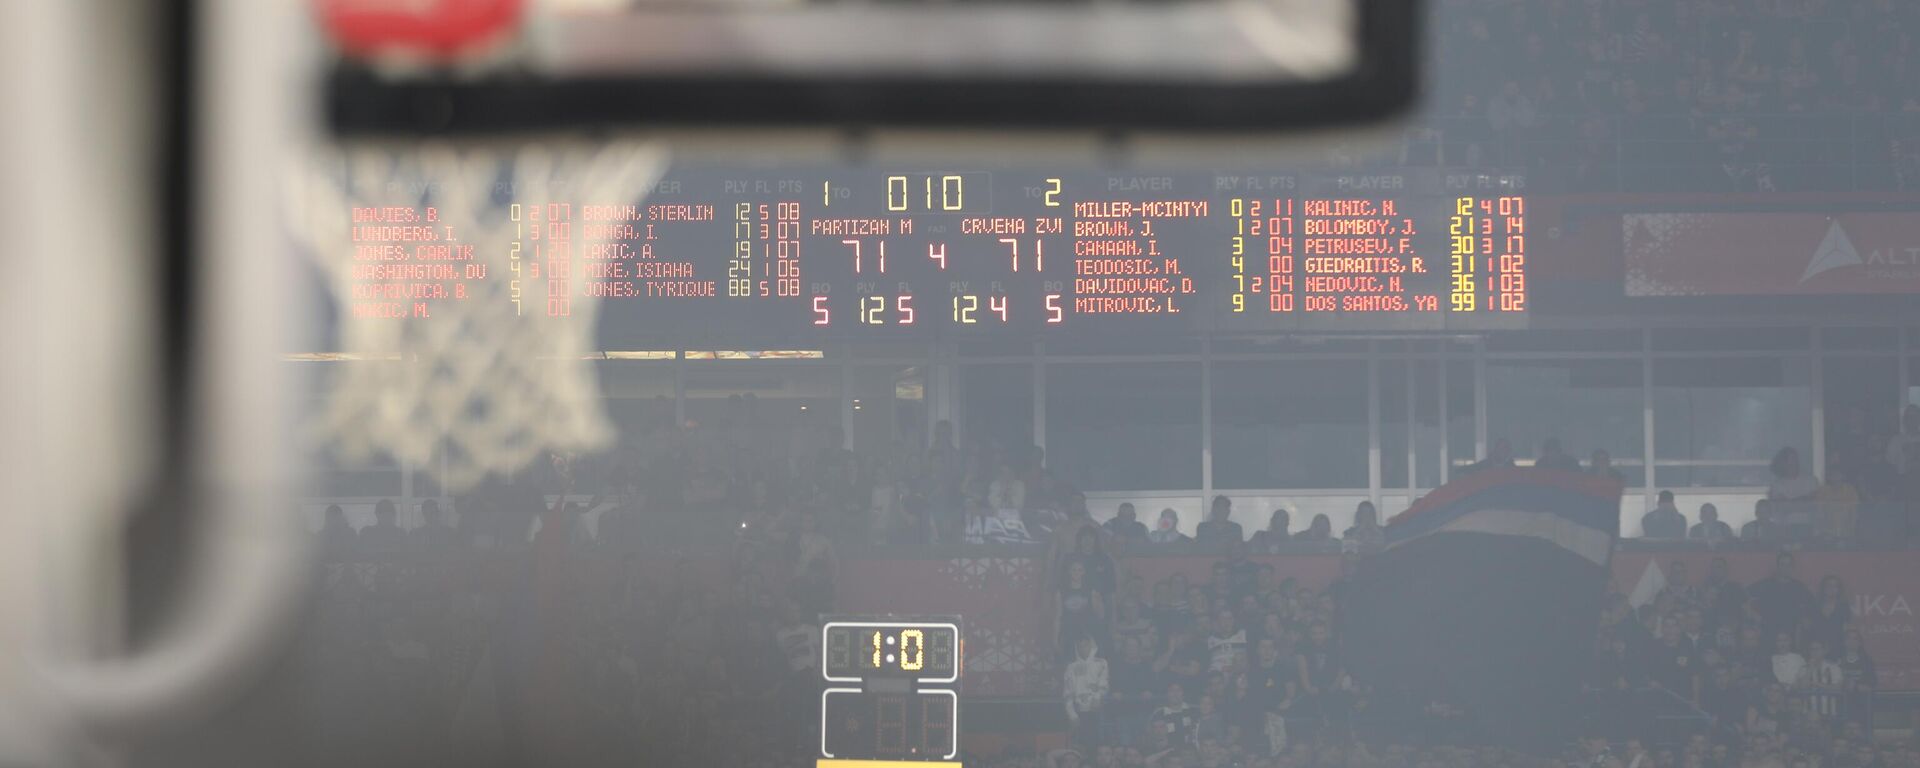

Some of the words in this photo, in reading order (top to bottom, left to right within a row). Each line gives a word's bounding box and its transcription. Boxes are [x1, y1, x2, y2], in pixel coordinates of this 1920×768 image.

[724, 180, 748, 193] PLY
[756, 180, 771, 193] FL
[778, 180, 803, 193] PTS
[1108, 177, 1173, 191] PLAYER
[1217, 177, 1240, 190] PLY
[1248, 177, 1262, 190] FL
[1270, 177, 1295, 189] PTS
[1338, 176, 1404, 189] PLAYER
[1446, 176, 1470, 188] PLY
[1500, 175, 1525, 188] PTS
[824, 180, 829, 207] 1
[832, 187, 851, 199] TO
[1024, 187, 1042, 198] TO
[1045, 178, 1061, 207] 2
[352, 207, 421, 222] DAVIES,
[427, 207, 441, 222] B.
[511, 203, 521, 221] 0
[529, 205, 540, 220] 2
[548, 203, 570, 221] 07
[583, 205, 641, 221] BROWN,
[648, 205, 714, 221] STERLIN
[734, 202, 751, 221] 12
[759, 204, 769, 220] 5
[777, 202, 800, 221] 08
[1074, 201, 1208, 217] MILLER-MCINTY
[1231, 198, 1242, 217] 0
[1250, 201, 1261, 217] 2
[1276, 199, 1293, 216] 11
[1305, 200, 1377, 216] KALINIC,
[1382, 200, 1398, 216] N.
[1456, 197, 1473, 215] 12
[1480, 200, 1492, 215] 4
[1499, 197, 1523, 216] 07
[352, 226, 439, 241] LUNDBERG,
[445, 225, 457, 241] I.
[517, 223, 521, 240] 1
[531, 224, 540, 240] 3
[548, 222, 570, 240] 00
[583, 224, 640, 240] BONGA,
[646, 224, 658, 240] I.
[734, 222, 751, 240] 17
[760, 224, 769, 240] 3
[777, 222, 800, 240] 07
[812, 218, 890, 235] PARTIZAN
[900, 218, 912, 235] M
[962, 218, 1025, 234] CRVENA
[1036, 218, 1062, 234] ZV
[1074, 221, 1134, 237] BROWN,
[1141, 221, 1155, 237] J.
[1238, 218, 1243, 236] 1
[1251, 220, 1261, 236] 2
[1269, 218, 1293, 236] 07
[1305, 219, 1396, 235] BOLOMBOY,
[1401, 219, 1416, 235] J.
[1450, 216, 1474, 235] 21
[1482, 218, 1492, 235] 3
[1506, 217, 1523, 234] 14
[353, 245, 410, 260] JONES,
[416, 245, 474, 260] CARLIK
[511, 241, 521, 260] 2
[583, 243, 635, 259] LAKIC,
[642, 243, 656, 259] A.
[734, 241, 751, 259] 19
[765, 243, 769, 258] 1
[777, 241, 800, 259] 07
[1075, 240, 1142, 256] CANAAN,
[1149, 240, 1161, 256] I.
[1232, 237, 1243, 255] 3
[1269, 237, 1293, 255] 04
[1305, 238, 1394, 254] PETRUSEV,
[1399, 238, 1414, 254] F.
[1451, 235, 1474, 254] 30
[1482, 237, 1492, 254] 3
[1507, 235, 1524, 254] 17
[842, 239, 884, 274] 71
[929, 243, 945, 270] 4
[999, 238, 1042, 273] 71
[1305, 257, 1407, 273] GIEDRAITIS,
[1411, 257, 1427, 273] R.
[1451, 254, 1474, 273] 31
[1488, 257, 1493, 272] 1
[1500, 254, 1524, 273] 02
[352, 264, 459, 280] WASHINGTON,
[466, 264, 486, 279] DU
[511, 261, 521, 278] 4
[531, 263, 540, 279] 3
[583, 262, 629, 278] MIKE,
[636, 262, 693, 278] ISIAHA
[728, 260, 751, 278] 24
[765, 262, 769, 277] 1
[777, 260, 800, 278] 06
[1075, 259, 1159, 275] TEODOSIC,
[1165, 259, 1182, 275] M.
[1232, 257, 1243, 274] 4
[1270, 256, 1293, 274] 00
[352, 283, 448, 299] KOPRIVICA,
[456, 283, 469, 298] B.
[583, 281, 640, 297] JONES,
[646, 281, 716, 297] TYRIQUE
[728, 279, 751, 297] 88
[759, 281, 769, 297] 5
[777, 279, 800, 297] 08
[811, 283, 831, 294] BO
[899, 282, 912, 292] FL
[991, 281, 1004, 292] FL
[1044, 281, 1063, 292] BO
[1075, 278, 1176, 294] DAVIDOVAC,
[1182, 278, 1196, 294] D.
[1233, 275, 1244, 293] 7
[1251, 277, 1262, 293] 2
[1270, 275, 1294, 293] 04
[1305, 276, 1384, 293] NEDOVIC,
[1389, 276, 1404, 293] N.
[1451, 274, 1475, 293] 36
[1488, 276, 1493, 291] 1
[1500, 274, 1525, 293] 03
[413, 302, 430, 318] M.
[511, 299, 521, 316] 7
[813, 296, 829, 325] 5
[860, 296, 885, 324] 12
[898, 295, 914, 324] 5
[953, 295, 977, 323] 12
[991, 295, 1007, 322] 4
[1046, 294, 1062, 323] 5
[1075, 297, 1162, 313] MITROVIC,
[1167, 297, 1180, 313] L.
[1233, 294, 1244, 312] 9
[1270, 294, 1294, 312] 00
[1305, 296, 1337, 312] DOS
[1343, 296, 1409, 312] SANTOS,
[1415, 296, 1438, 312] YA
[1451, 293, 1475, 312] 99
[1488, 296, 1494, 311] 1
[1500, 293, 1525, 312] 02
